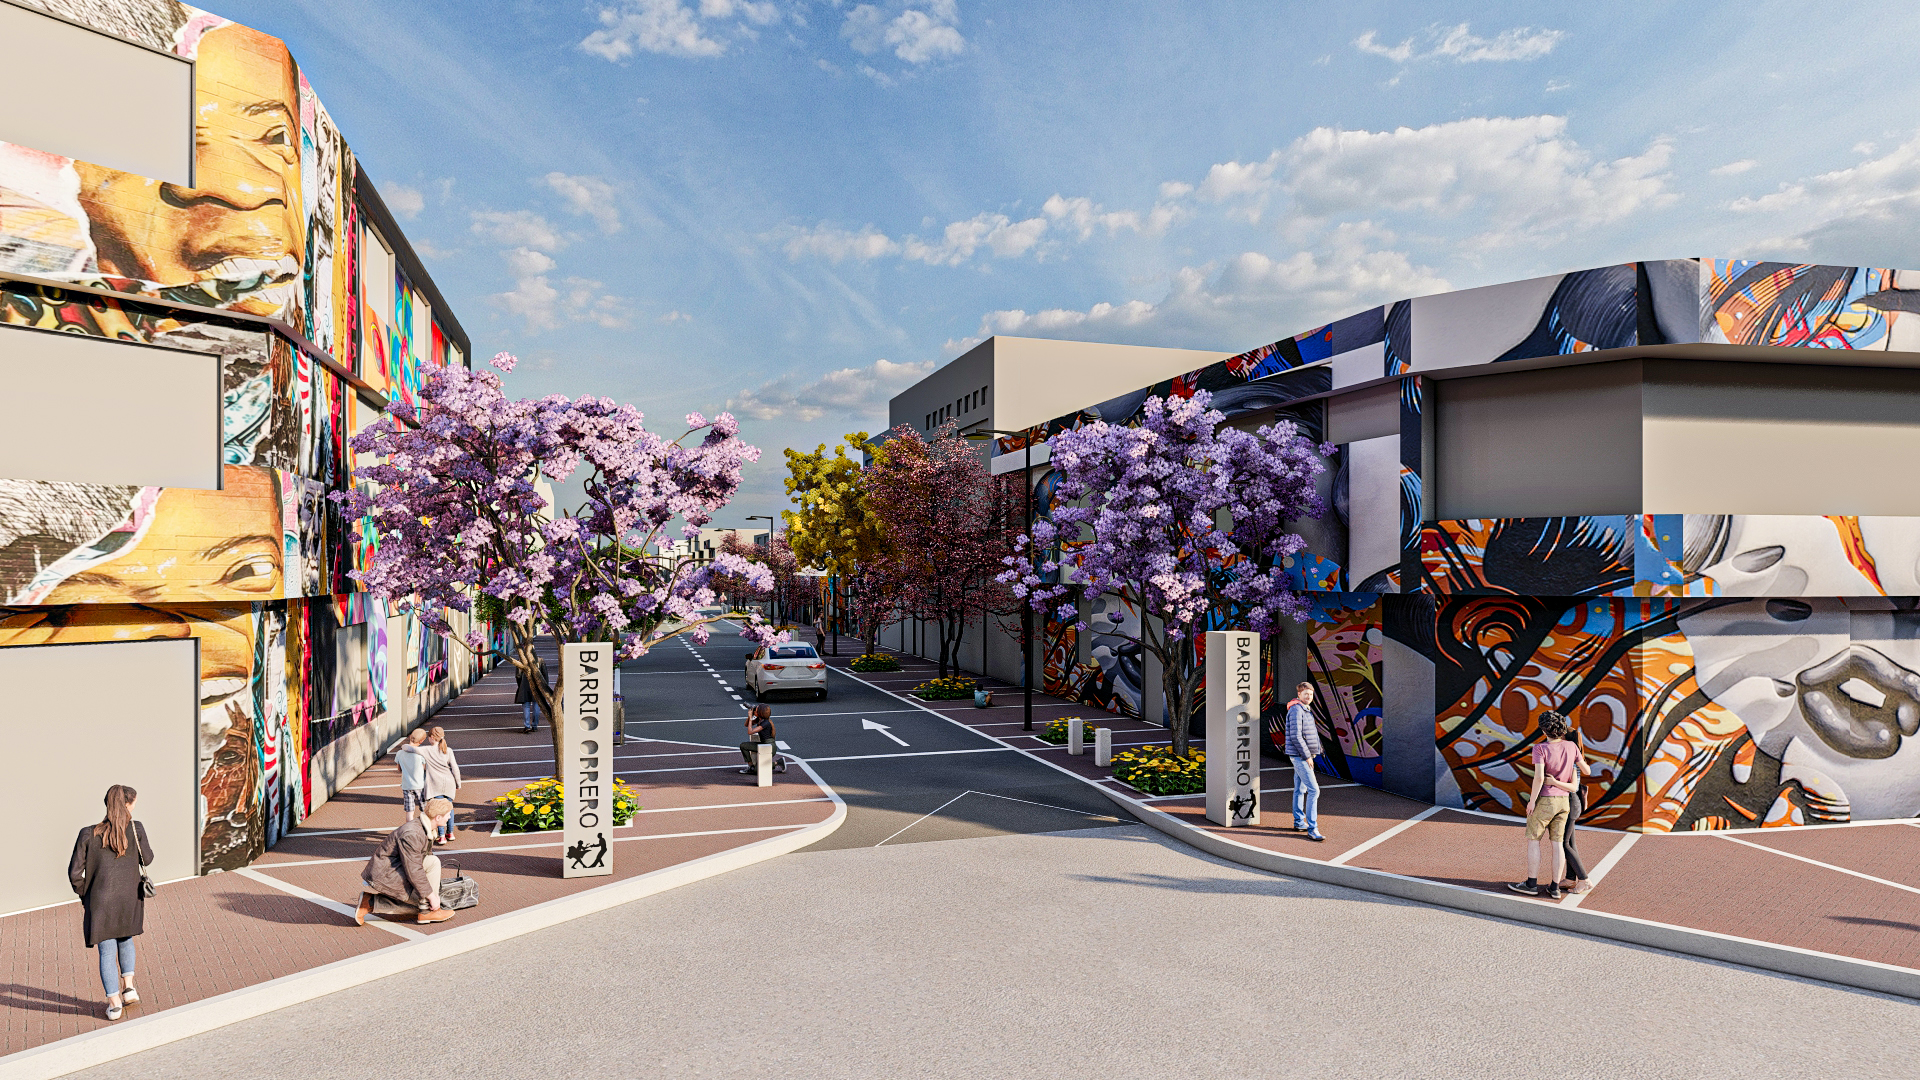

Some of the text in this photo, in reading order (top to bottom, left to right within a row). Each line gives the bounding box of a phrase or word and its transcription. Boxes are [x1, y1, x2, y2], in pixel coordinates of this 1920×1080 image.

[579, 650, 599, 828] BARRIO OBRERO
[1236, 637, 1251, 786] BARRIO OBRERO
